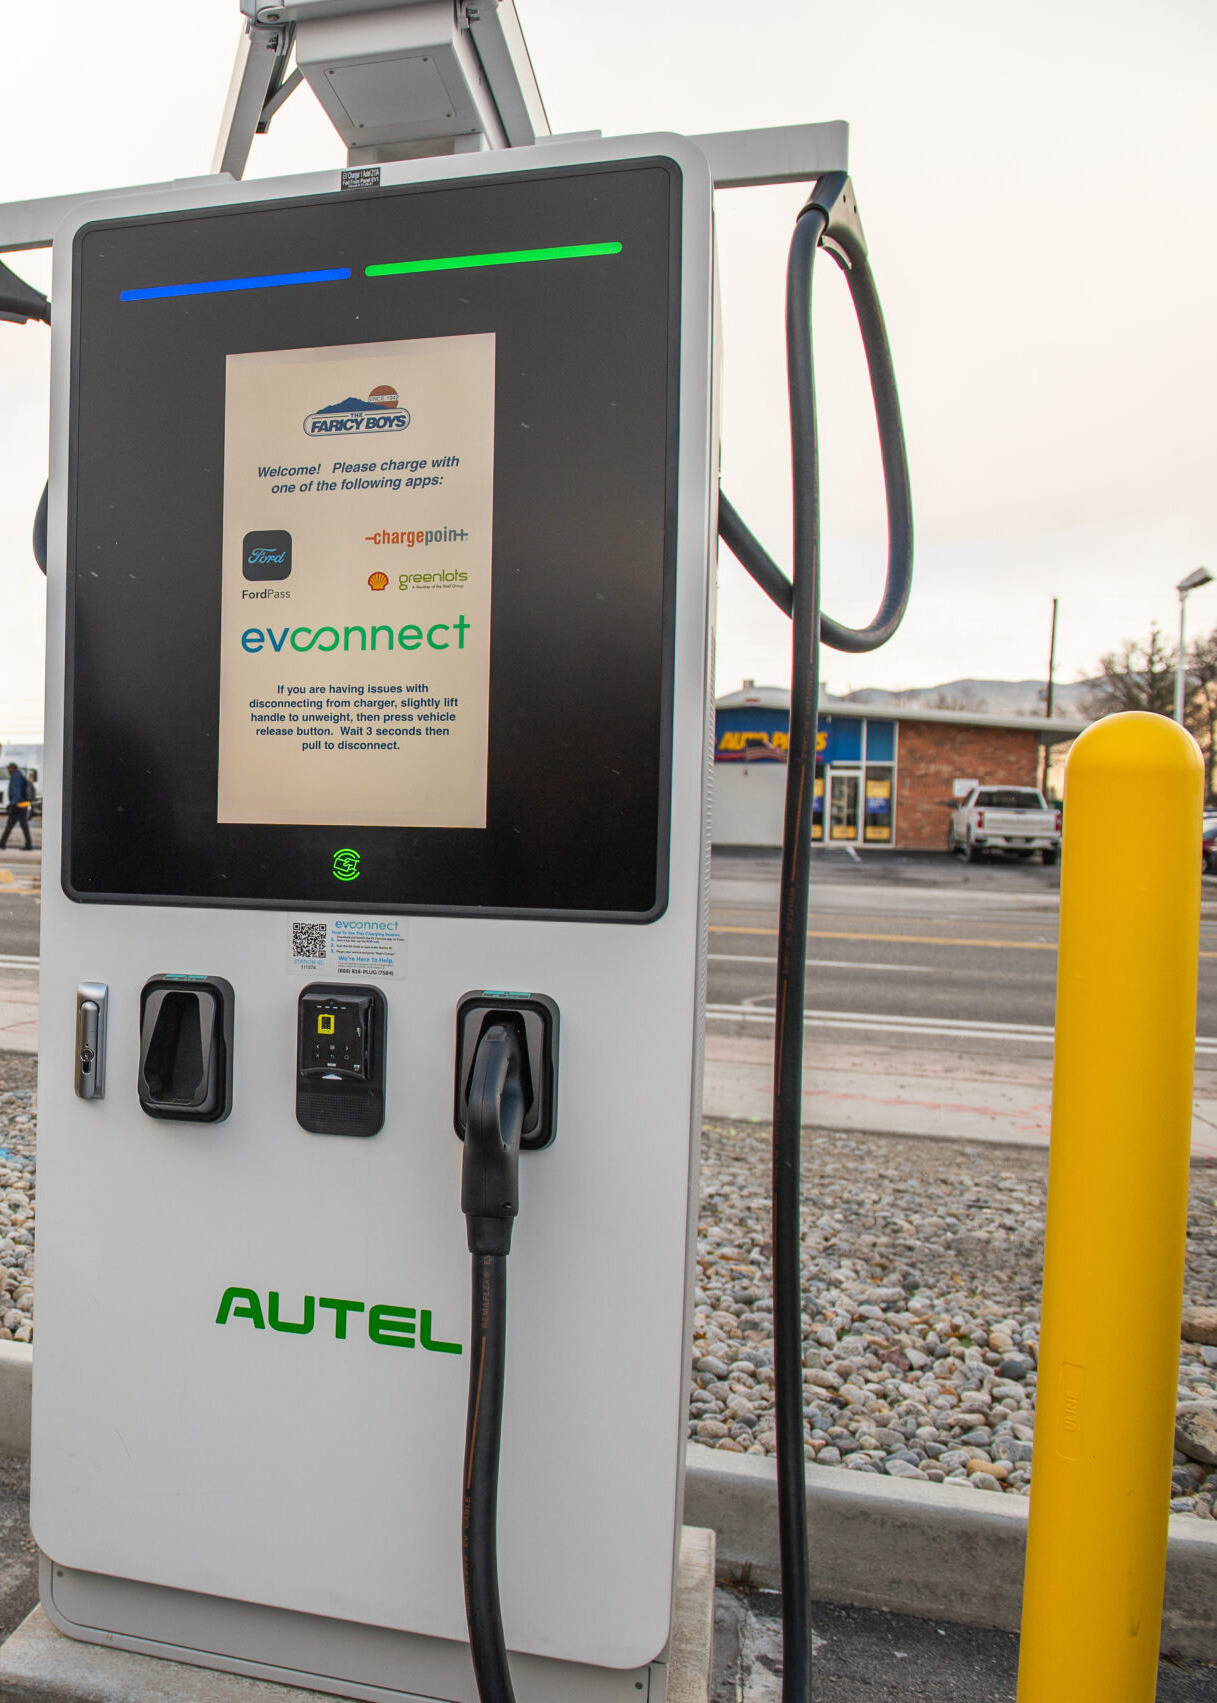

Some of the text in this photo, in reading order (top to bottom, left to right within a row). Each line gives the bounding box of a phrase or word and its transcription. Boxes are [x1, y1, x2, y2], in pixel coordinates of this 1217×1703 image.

[311, 415, 406, 433] FARICY BOYS
[258, 456, 460, 478] Welcome! Please charge with
[271, 475, 444, 494] one of the following apps:
[247, 548, 286, 564] Ford
[398, 569, 468, 590] greenlots
[242, 588, 291, 600] FordPass
[241, 615, 471, 653] evconnect
[277, 684, 428, 696] If you are having issues with
[249, 698, 458, 709] disconnecting from charger, slightly lift
[250, 712, 456, 723] handle to unweight, then press vehicle
[256, 726, 450, 736] release button. Wait 3 seconds then
[302, 740, 400, 751] pull to disconnect.
[335, 920, 398, 931] evconnect
[215, 1287, 462, 1356] AUTEL
